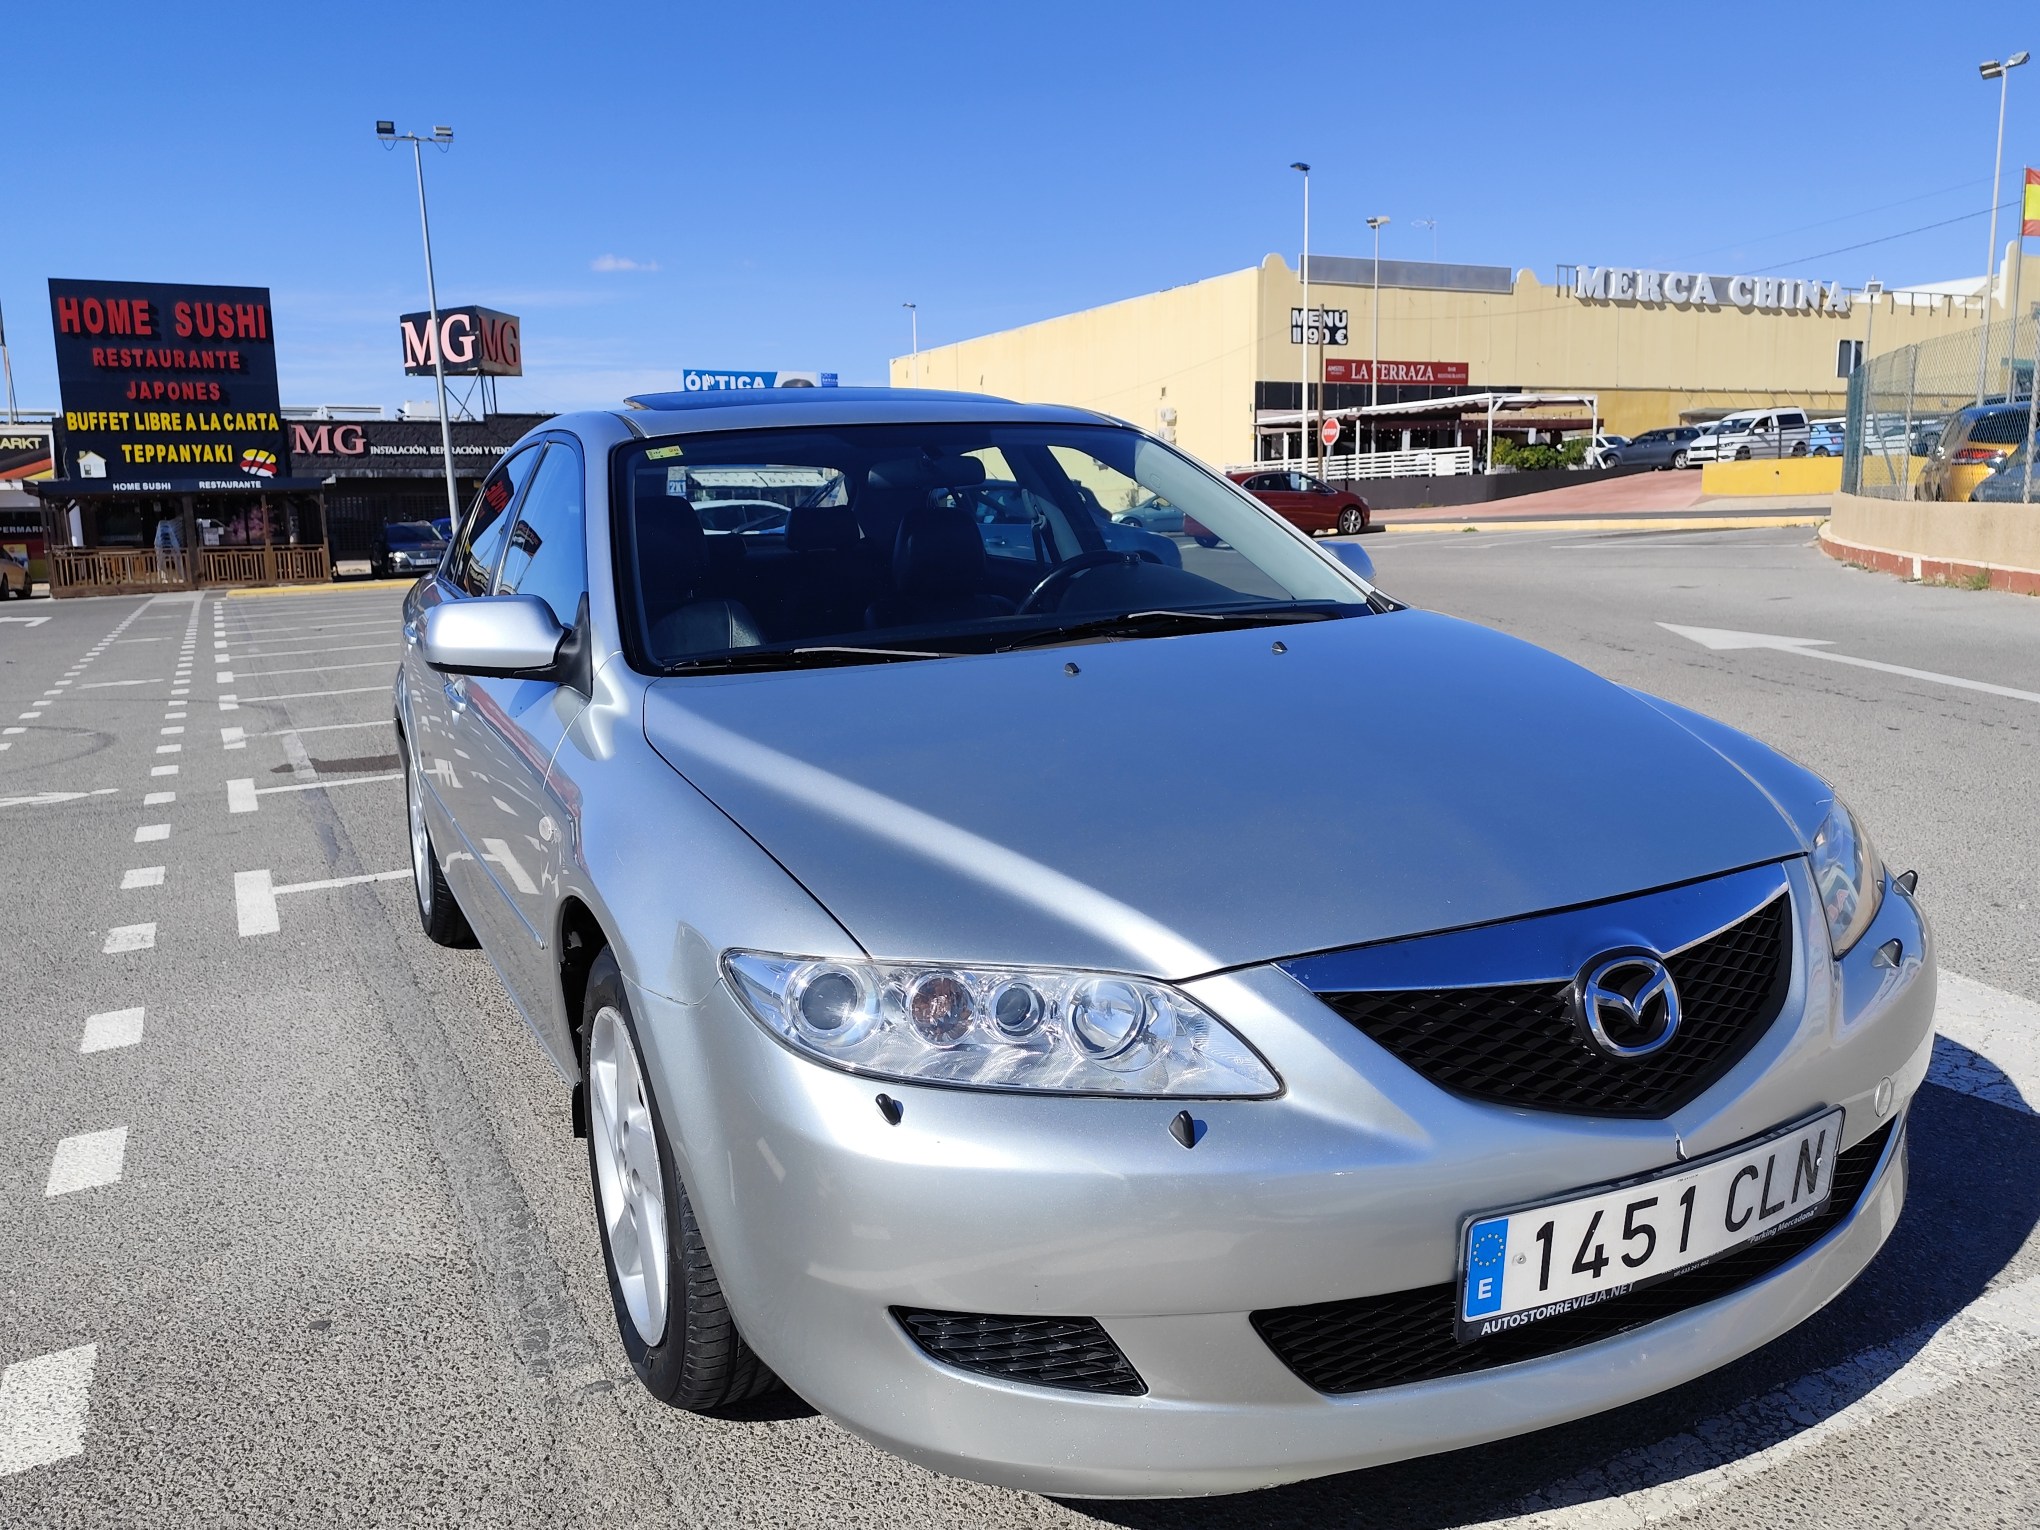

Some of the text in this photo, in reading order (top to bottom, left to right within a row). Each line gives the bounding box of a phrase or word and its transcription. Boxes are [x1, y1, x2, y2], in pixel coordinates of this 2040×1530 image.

[1575, 264, 1848, 312] MERCA CHINA
[57, 297, 266, 339] HOME SUSHI
[400, 313, 476, 367] MG
[477, 315, 518, 367] MG
[92, 347, 241, 370] RESTAURANTE
[685, 371, 765, 391] ÓPTICA
[1351, 362, 1434, 381] LA TERRAZA
[126, 381, 220, 401] JAPONES
[66, 411, 279, 432] BUFFET LIBRE A LA CARTA
[290, 424, 367, 455] MG
[482, 446, 490, 454] Y
[121, 444, 234, 463] TEPPANYAKI
[112, 480, 262, 491] HOME SUSHI RESTAURANTE
[1535, 1130, 1826, 1291] 1451 CLN
[1477, 1277, 1493, 1300] E
[1481, 1281, 1635, 1336] AUTOSTORREVIEJA.NET
